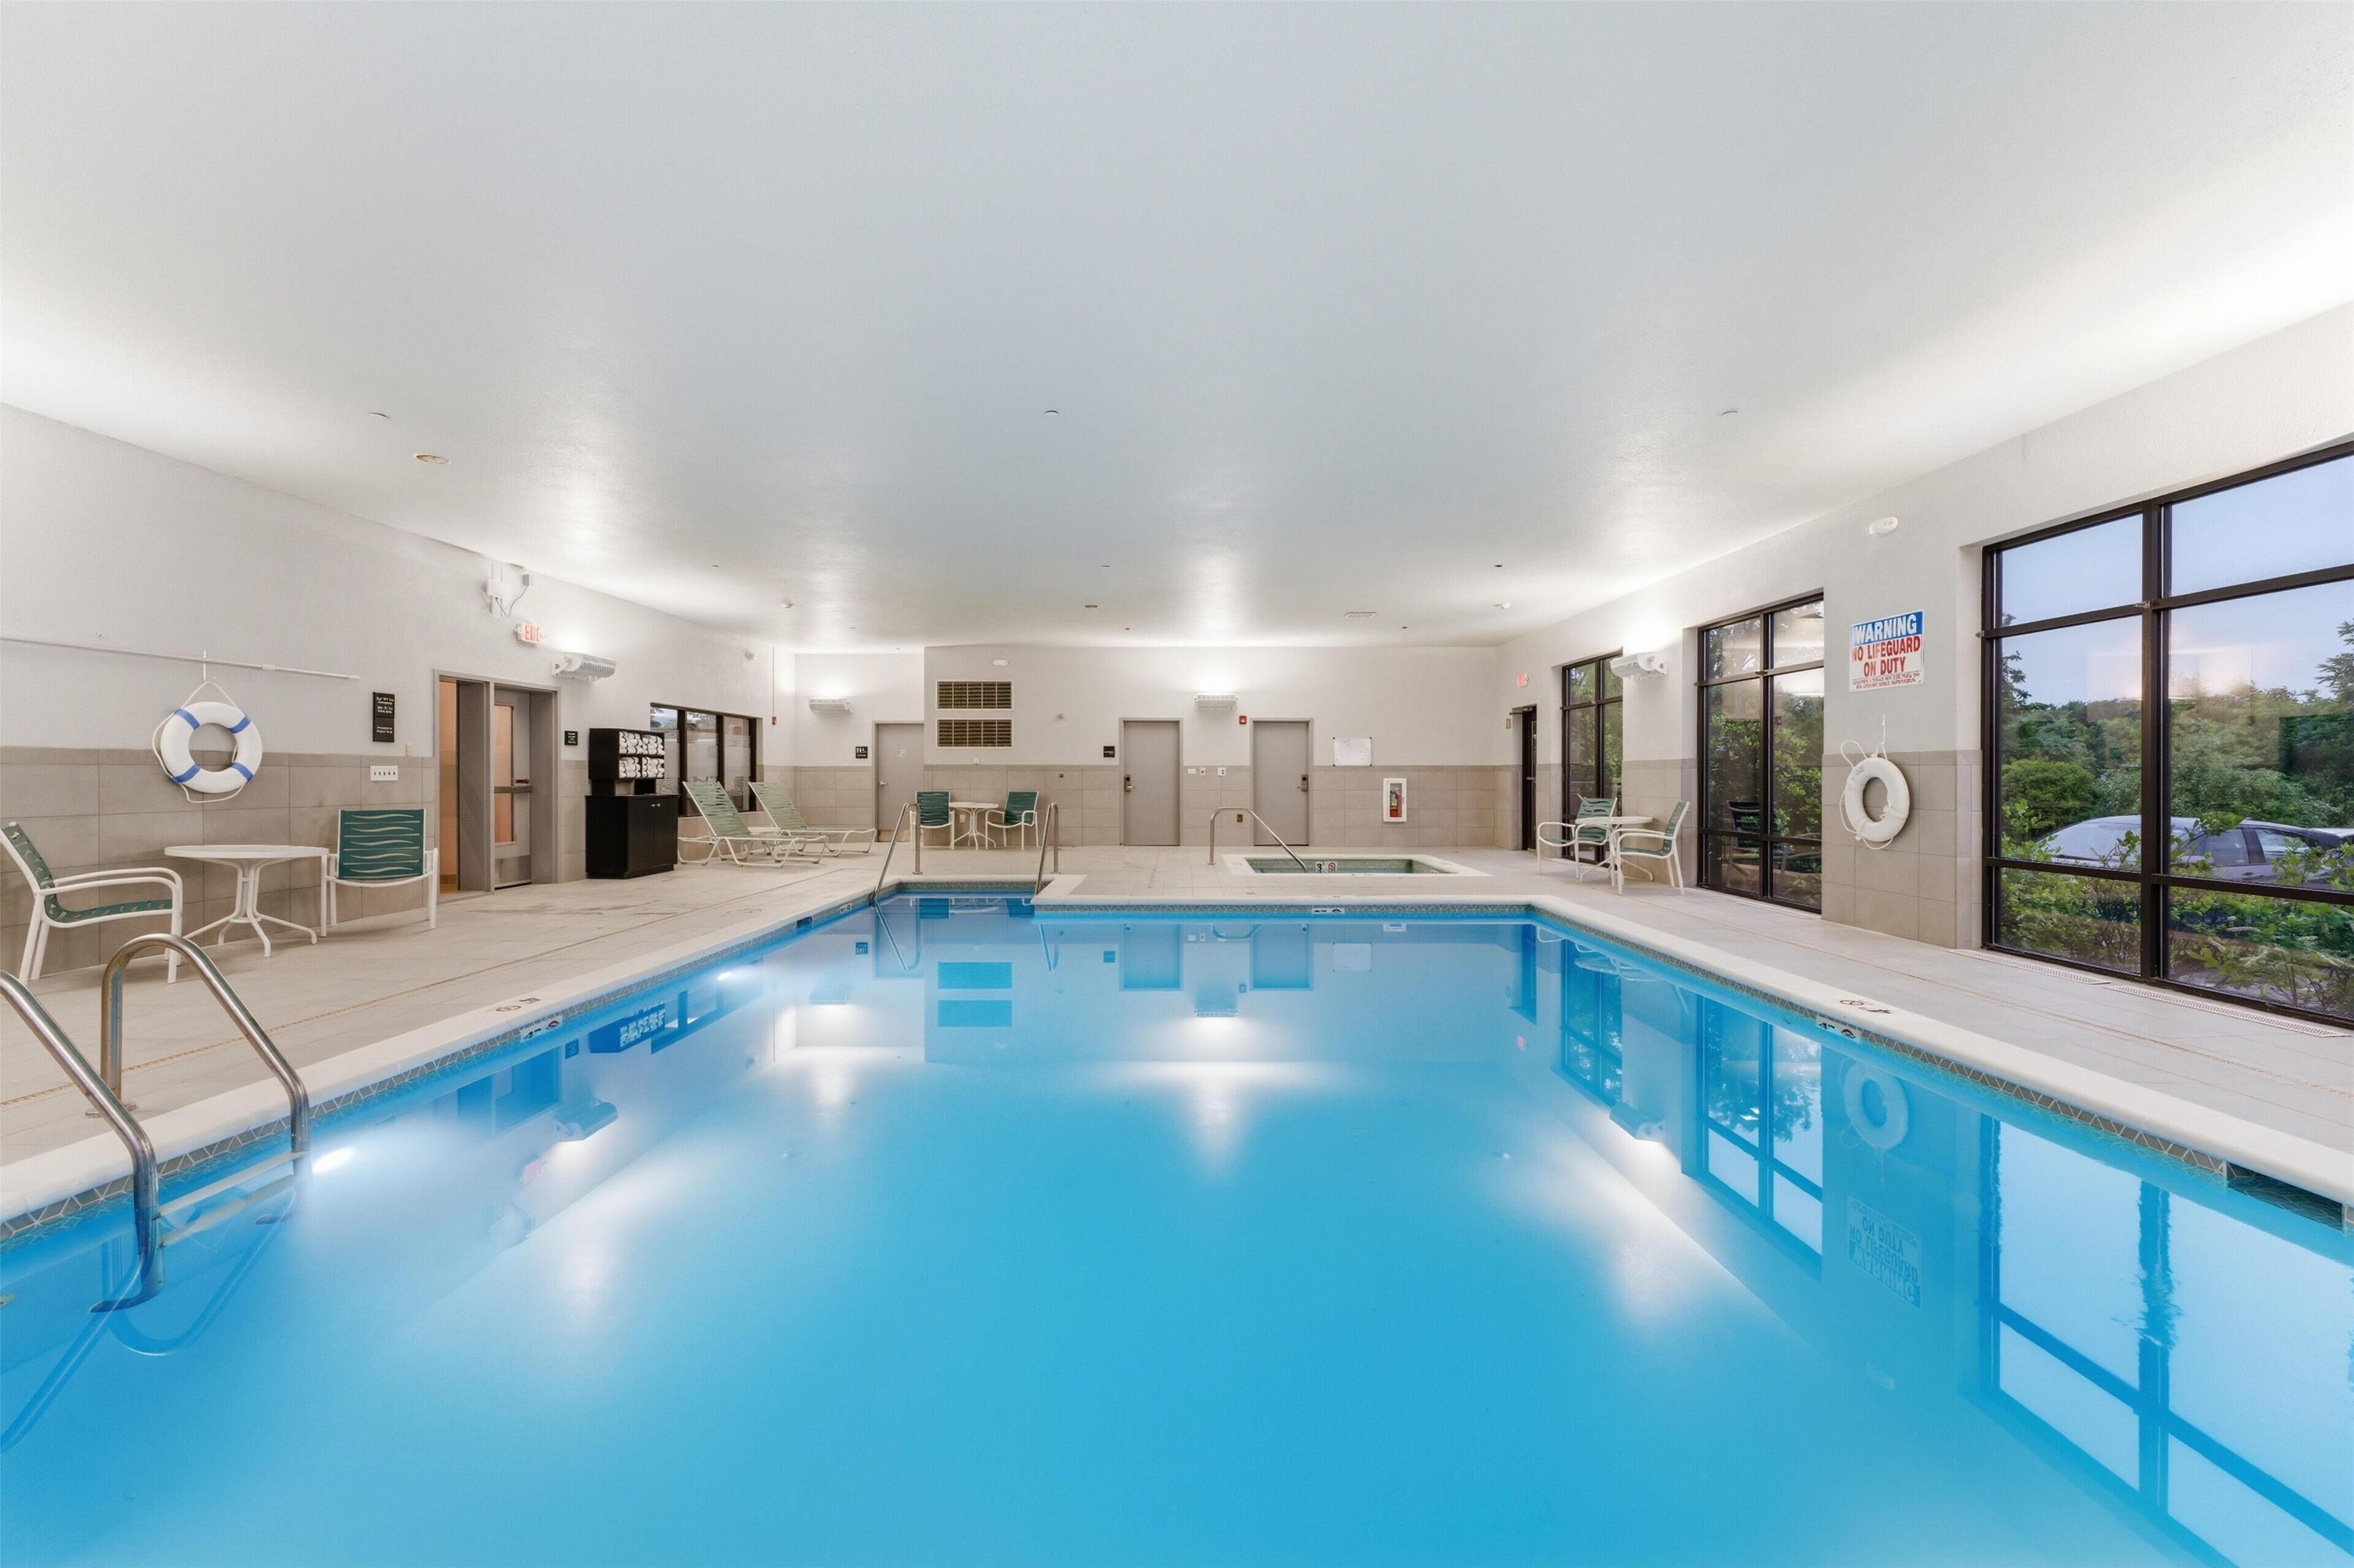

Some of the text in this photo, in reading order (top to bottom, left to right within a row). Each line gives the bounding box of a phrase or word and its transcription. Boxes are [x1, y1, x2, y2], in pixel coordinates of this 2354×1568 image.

[1854, 614, 1917, 644] WARNING
[1852, 635, 1921, 663] NO LIFEGUARD
[1864, 656, 1906, 677] ON DUTY
